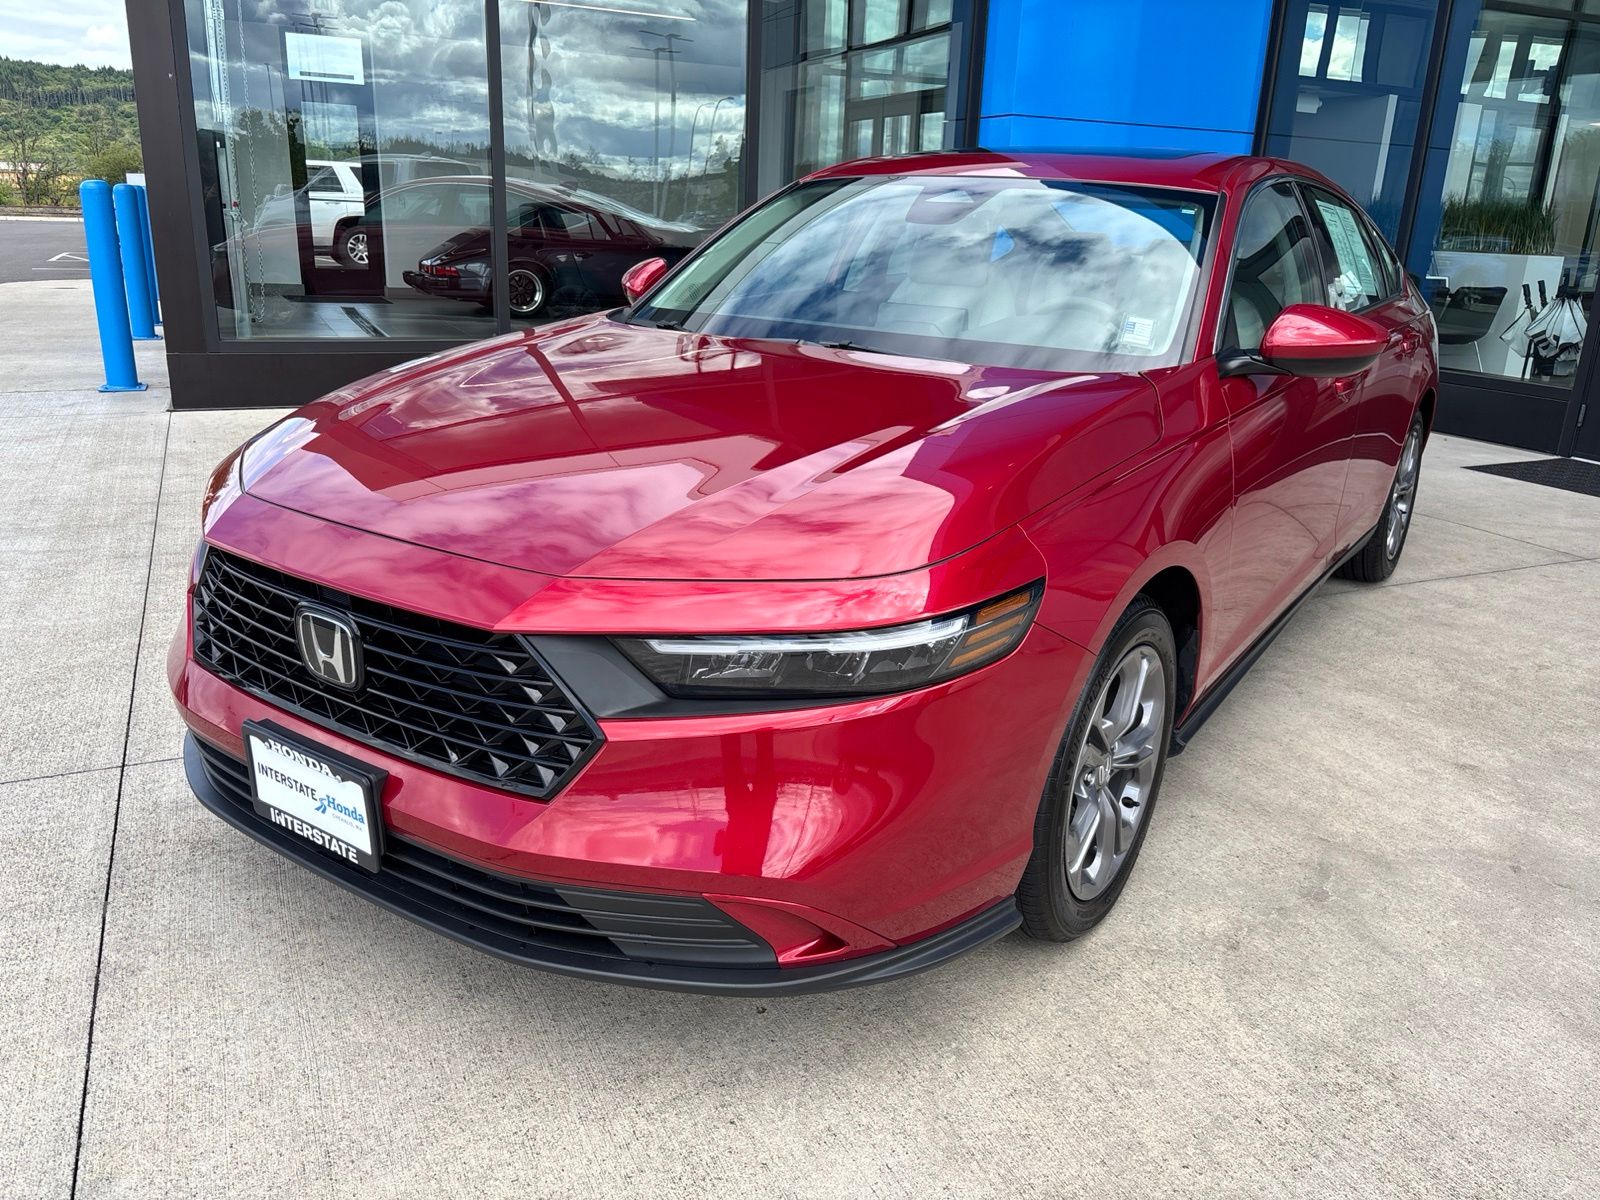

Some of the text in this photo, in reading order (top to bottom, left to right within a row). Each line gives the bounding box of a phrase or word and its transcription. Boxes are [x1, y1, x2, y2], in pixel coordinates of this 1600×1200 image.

[268, 738, 336, 779] HONDA
[257, 761, 318, 802] INTERSTATE
[326, 794, 365, 825] Honda
[269, 807, 359, 864] INTERSTATE
